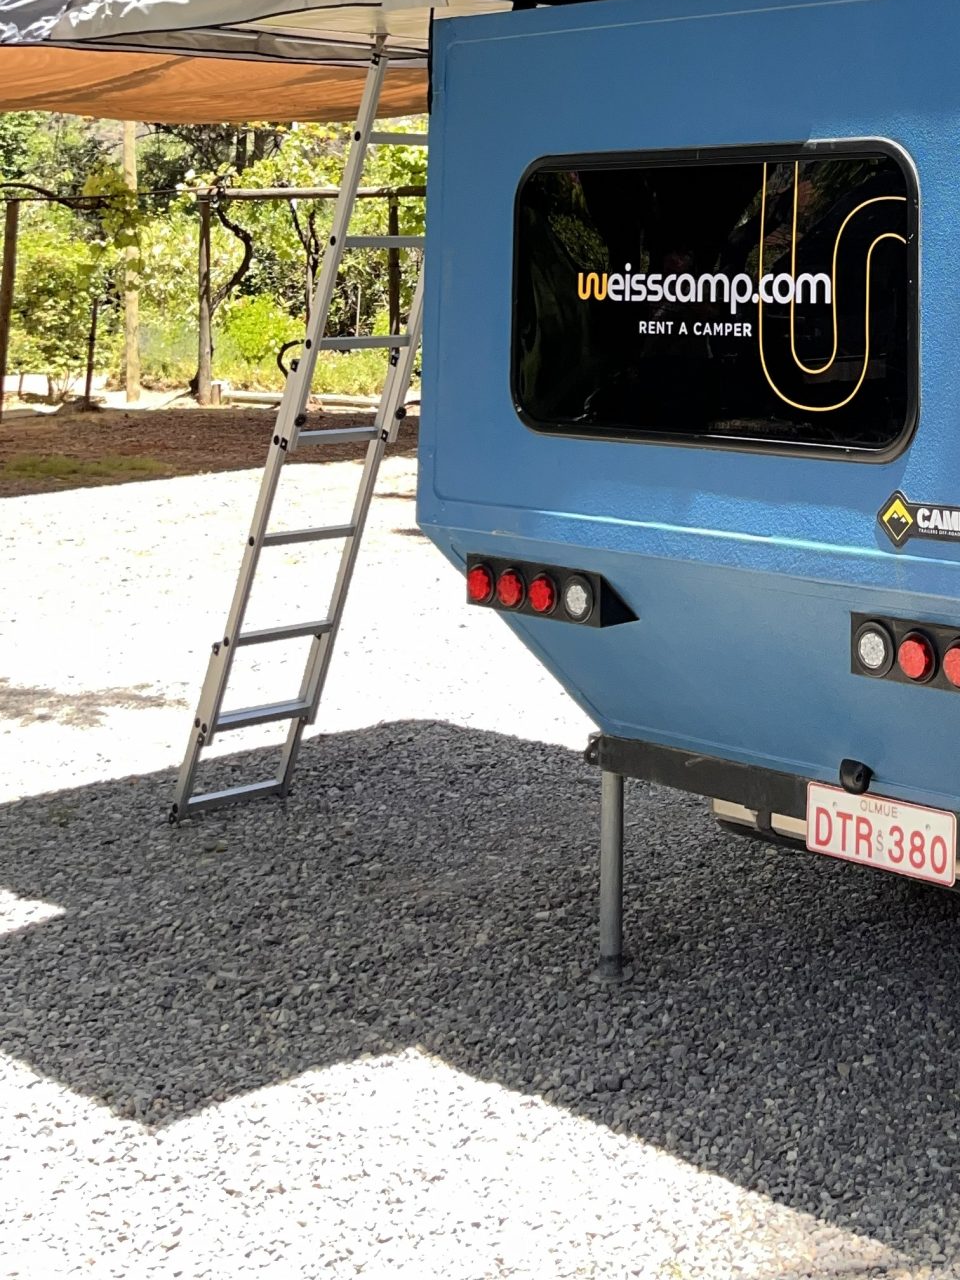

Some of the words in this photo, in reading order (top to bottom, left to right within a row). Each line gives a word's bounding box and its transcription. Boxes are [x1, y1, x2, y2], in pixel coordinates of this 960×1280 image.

[578, 262, 831, 315] weisscamp.com
[638, 321, 674, 335] RENT
[678, 322, 688, 335] A
[693, 322, 752, 337] CAMPER
[859, 799, 898, 819] OLMUE
